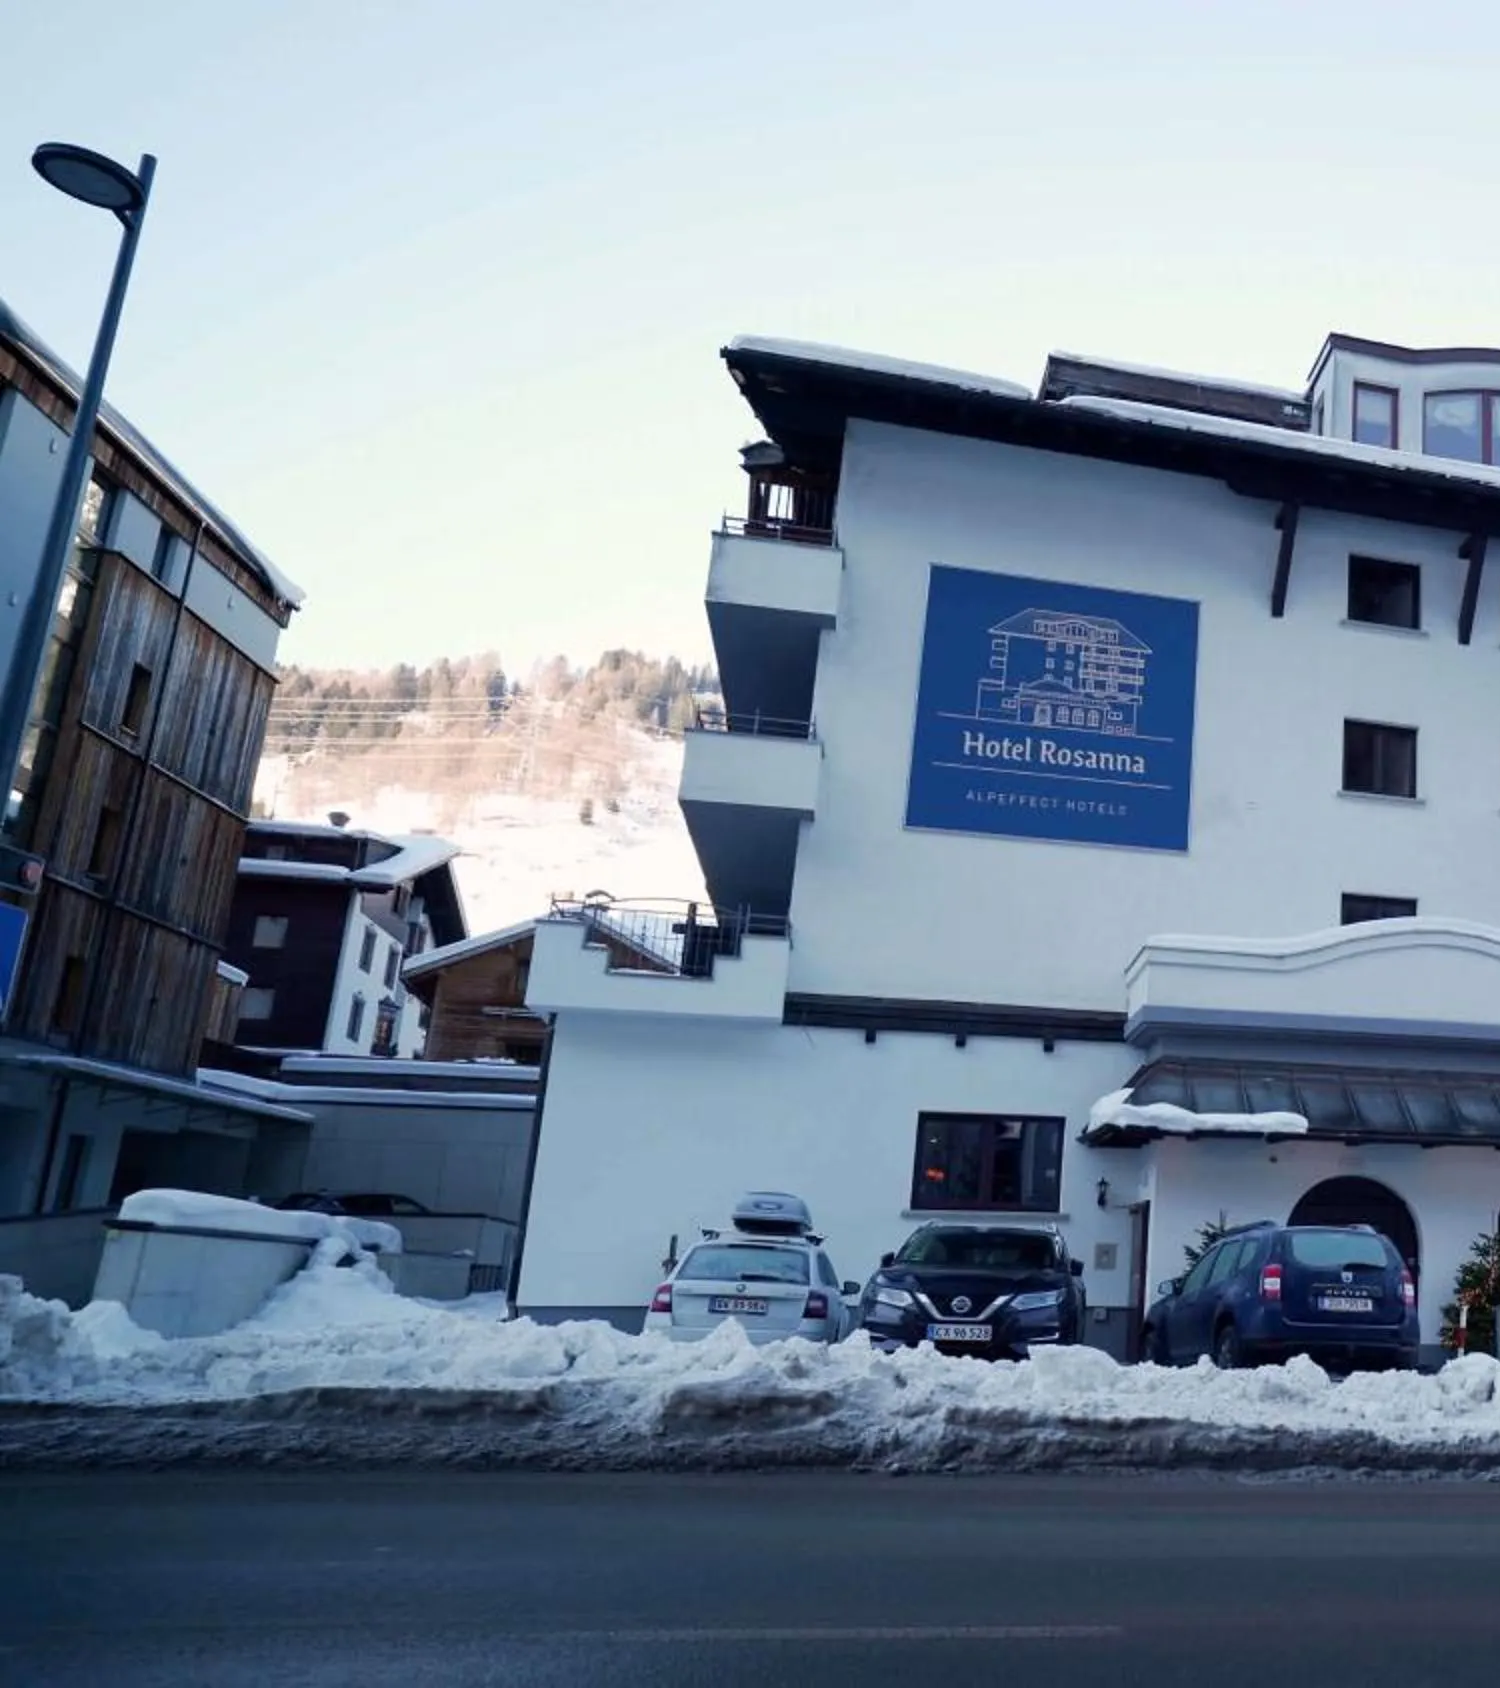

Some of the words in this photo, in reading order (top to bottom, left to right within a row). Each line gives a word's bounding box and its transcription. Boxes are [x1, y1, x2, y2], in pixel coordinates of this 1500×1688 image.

[962, 730, 1031, 762] Hotel
[1039, 739, 1146, 774] Rosanna
[965, 789, 1057, 809] ALPEFFECT
[1066, 801, 1128, 816] HOTELS
